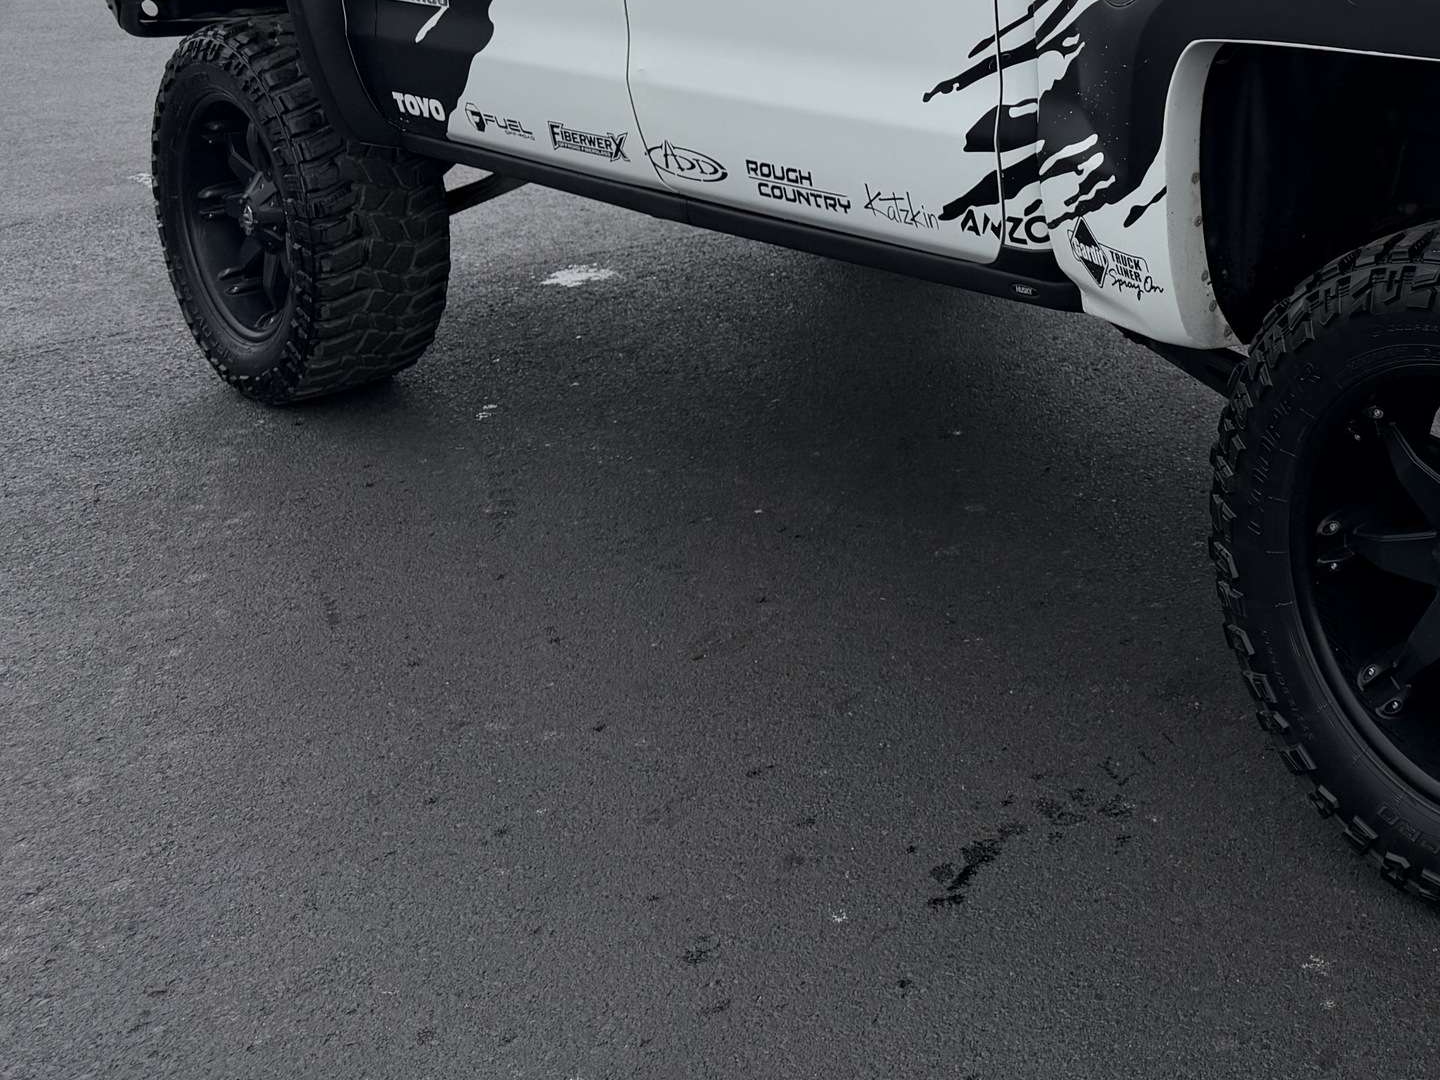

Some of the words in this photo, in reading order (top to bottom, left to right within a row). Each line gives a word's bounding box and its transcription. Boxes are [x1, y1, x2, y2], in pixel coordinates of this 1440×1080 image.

[392, 91, 446, 122] TOYO
[483, 113, 533, 135] FUEL
[745, 159, 813, 187] ROUGH
[757, 182, 851, 215] COUNTRY
[863, 182, 940, 230] Katzkin
[960, 208, 1051, 245] ANZO
[1109, 249, 1142, 272] TRUCK
[1115, 264, 1142, 282] LINER
[1108, 268, 1145, 301] Spray
[1143, 275, 1164, 293] On
